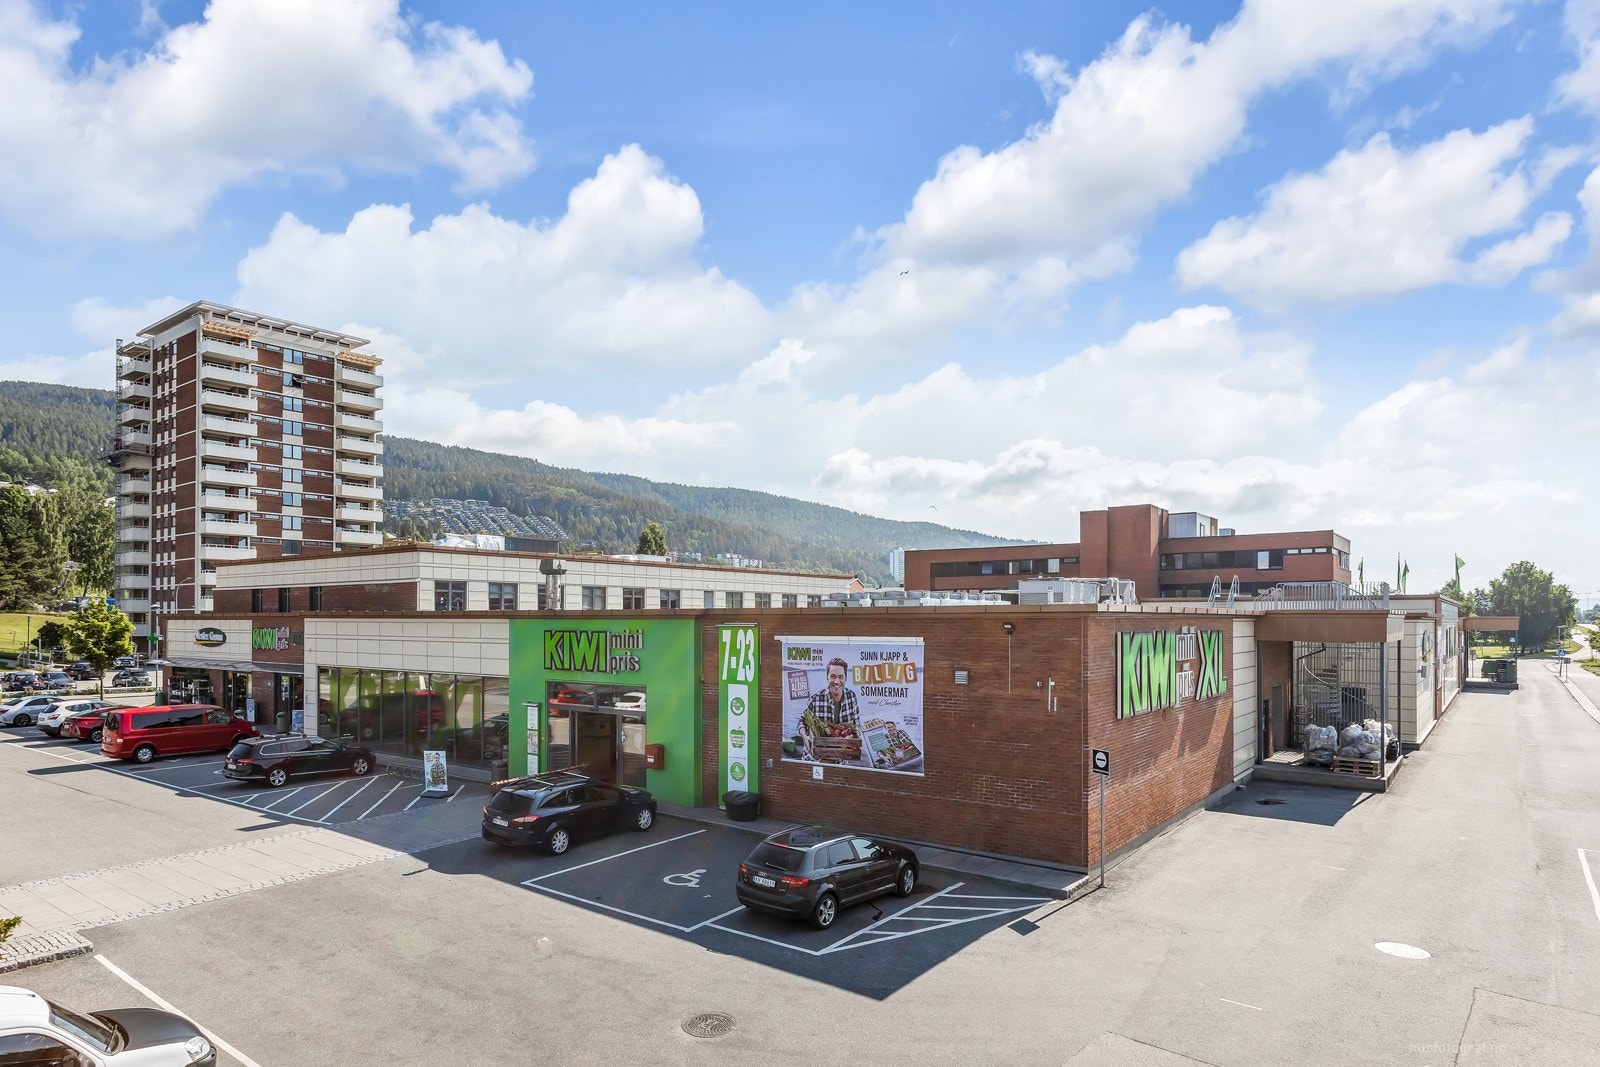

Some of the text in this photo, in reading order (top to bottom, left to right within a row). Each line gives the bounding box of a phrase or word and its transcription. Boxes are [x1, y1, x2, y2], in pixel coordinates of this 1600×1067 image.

[252, 628, 277, 650] KIWI
[610, 629, 642, 649] mini
[1176, 626, 1197, 661] mini
[544, 630, 609, 673] KIWI
[722, 629, 755, 682] 7-23
[787, 647, 811, 661] KIWI
[860, 651, 909, 662] SUNN KJAPP &
[610, 652, 640, 675] pris
[854, 664, 915, 681] BILLIG
[1117, 631, 1176, 719] KIWI
[1196, 630, 1227, 700] XL
[860, 686, 909, 698] SOMMERMAT
[1175, 663, 1195, 707] pris
